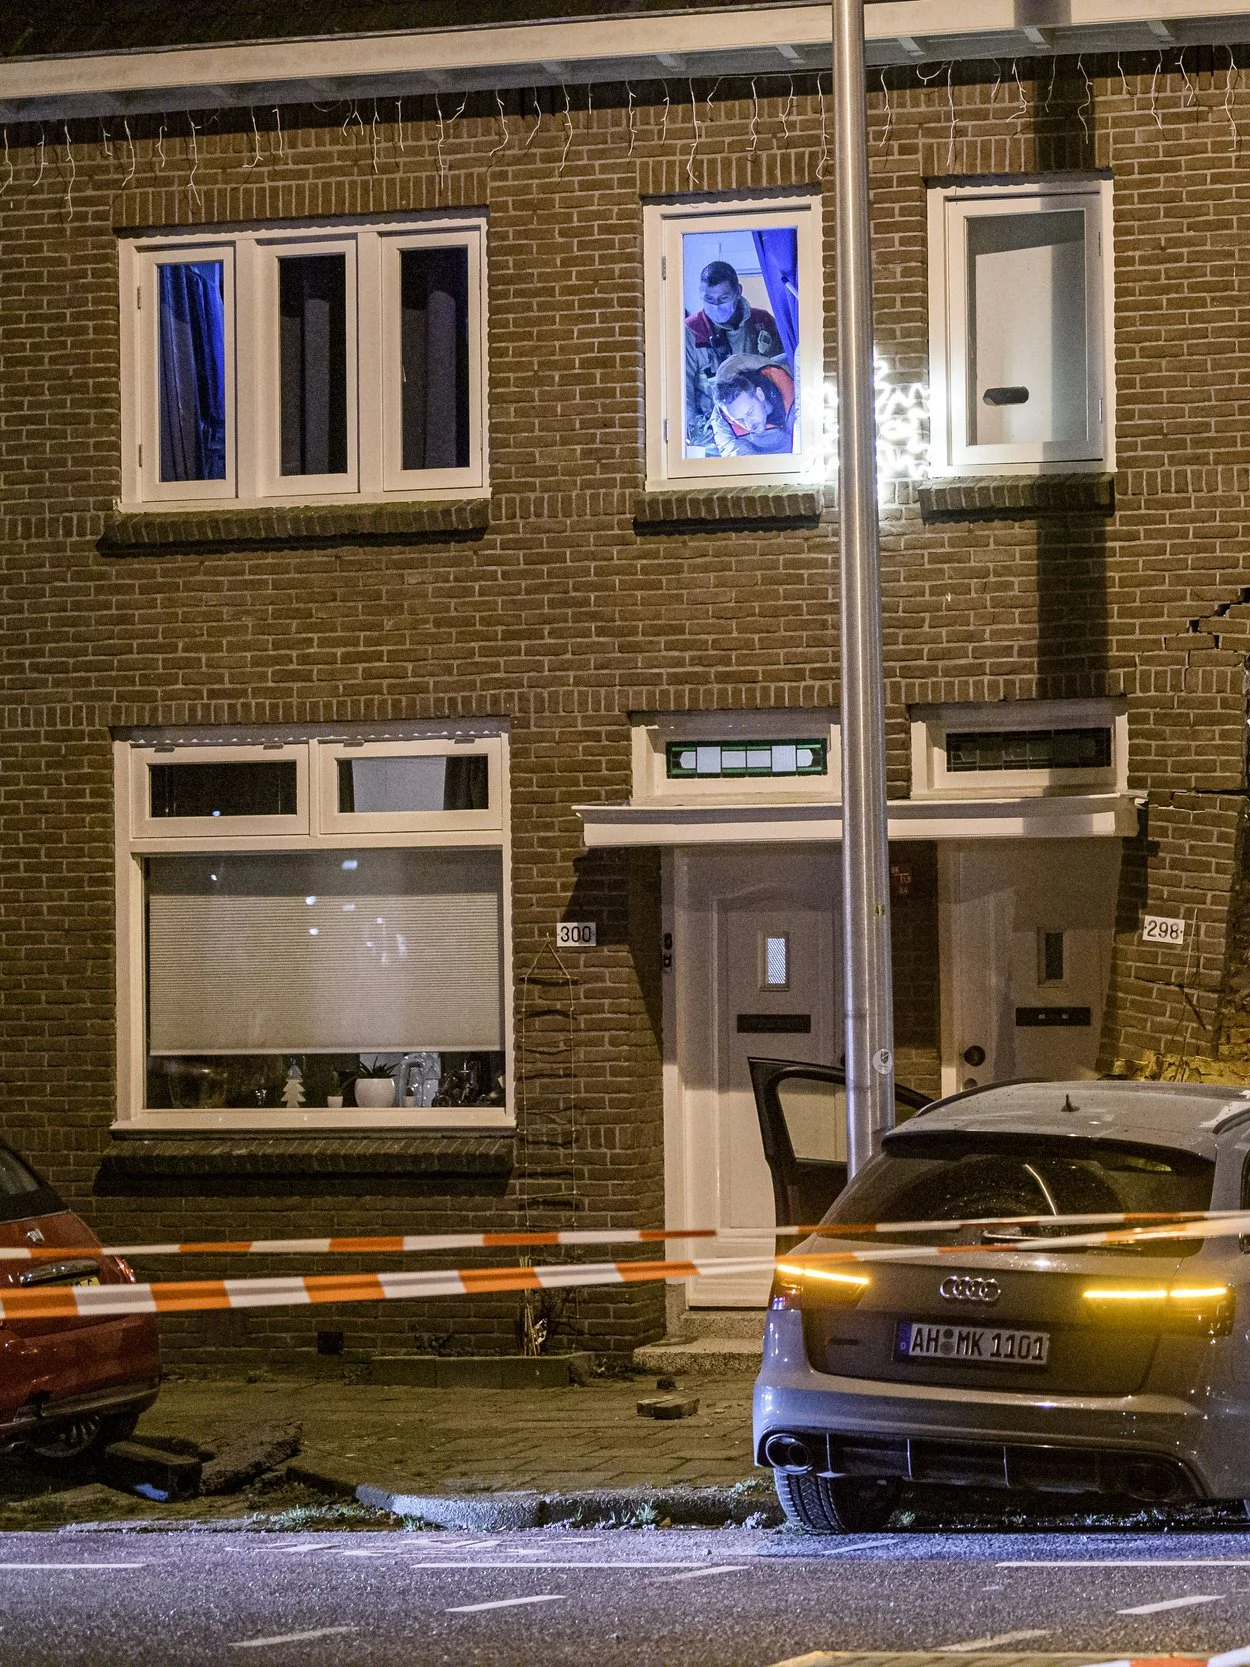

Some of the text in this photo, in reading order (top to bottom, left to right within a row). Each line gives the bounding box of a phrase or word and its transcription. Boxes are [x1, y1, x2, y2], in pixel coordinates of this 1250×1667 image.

[560, 925, 591, 943] 300
[1147, 920, 1179, 940] 298
[911, 1327, 1045, 1361] AH MK 1101
